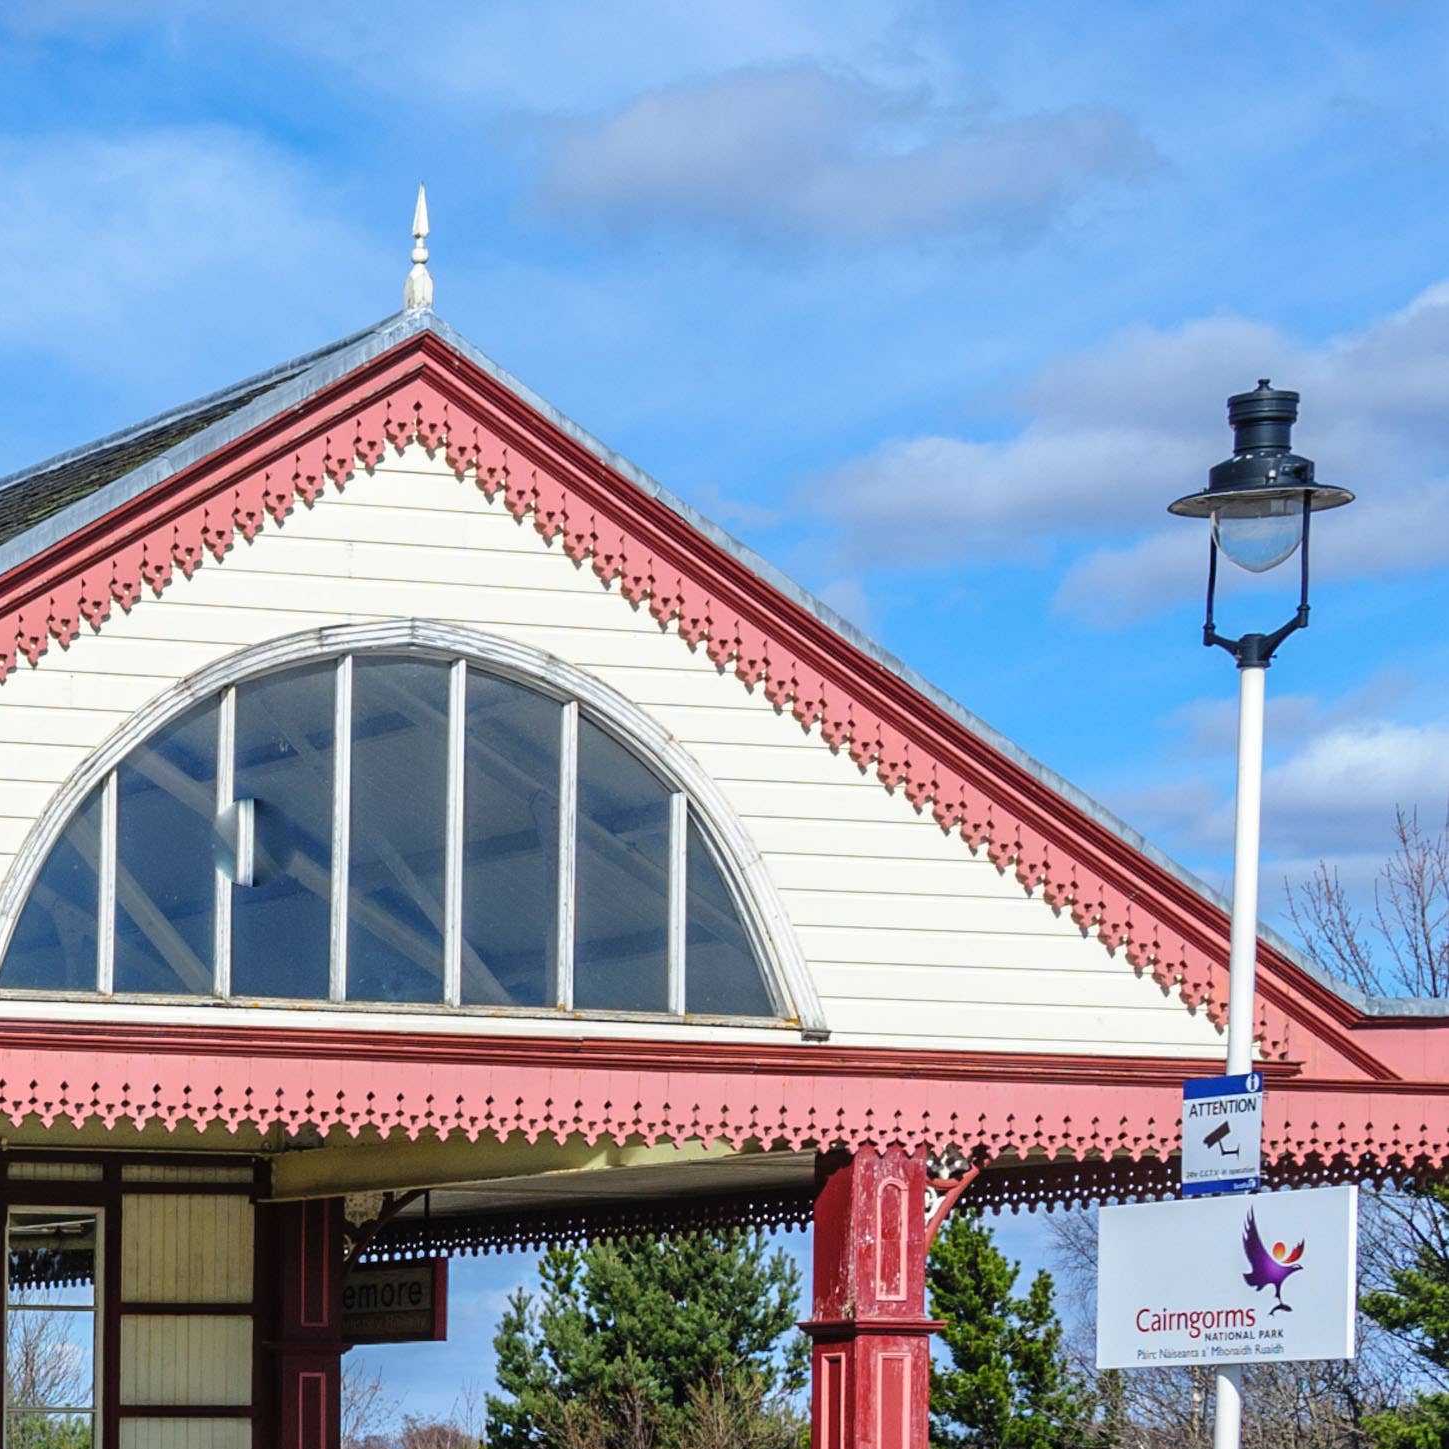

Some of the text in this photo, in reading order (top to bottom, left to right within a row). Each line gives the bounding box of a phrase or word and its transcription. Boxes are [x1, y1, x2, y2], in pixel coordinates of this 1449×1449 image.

[1188, 1097, 1257, 1118] ATTENTION
[343, 1281, 423, 1310] emore
[1136, 1308, 1256, 1339] Cairngorms
[1204, 1329, 1284, 1342] NATIONAL PARK
